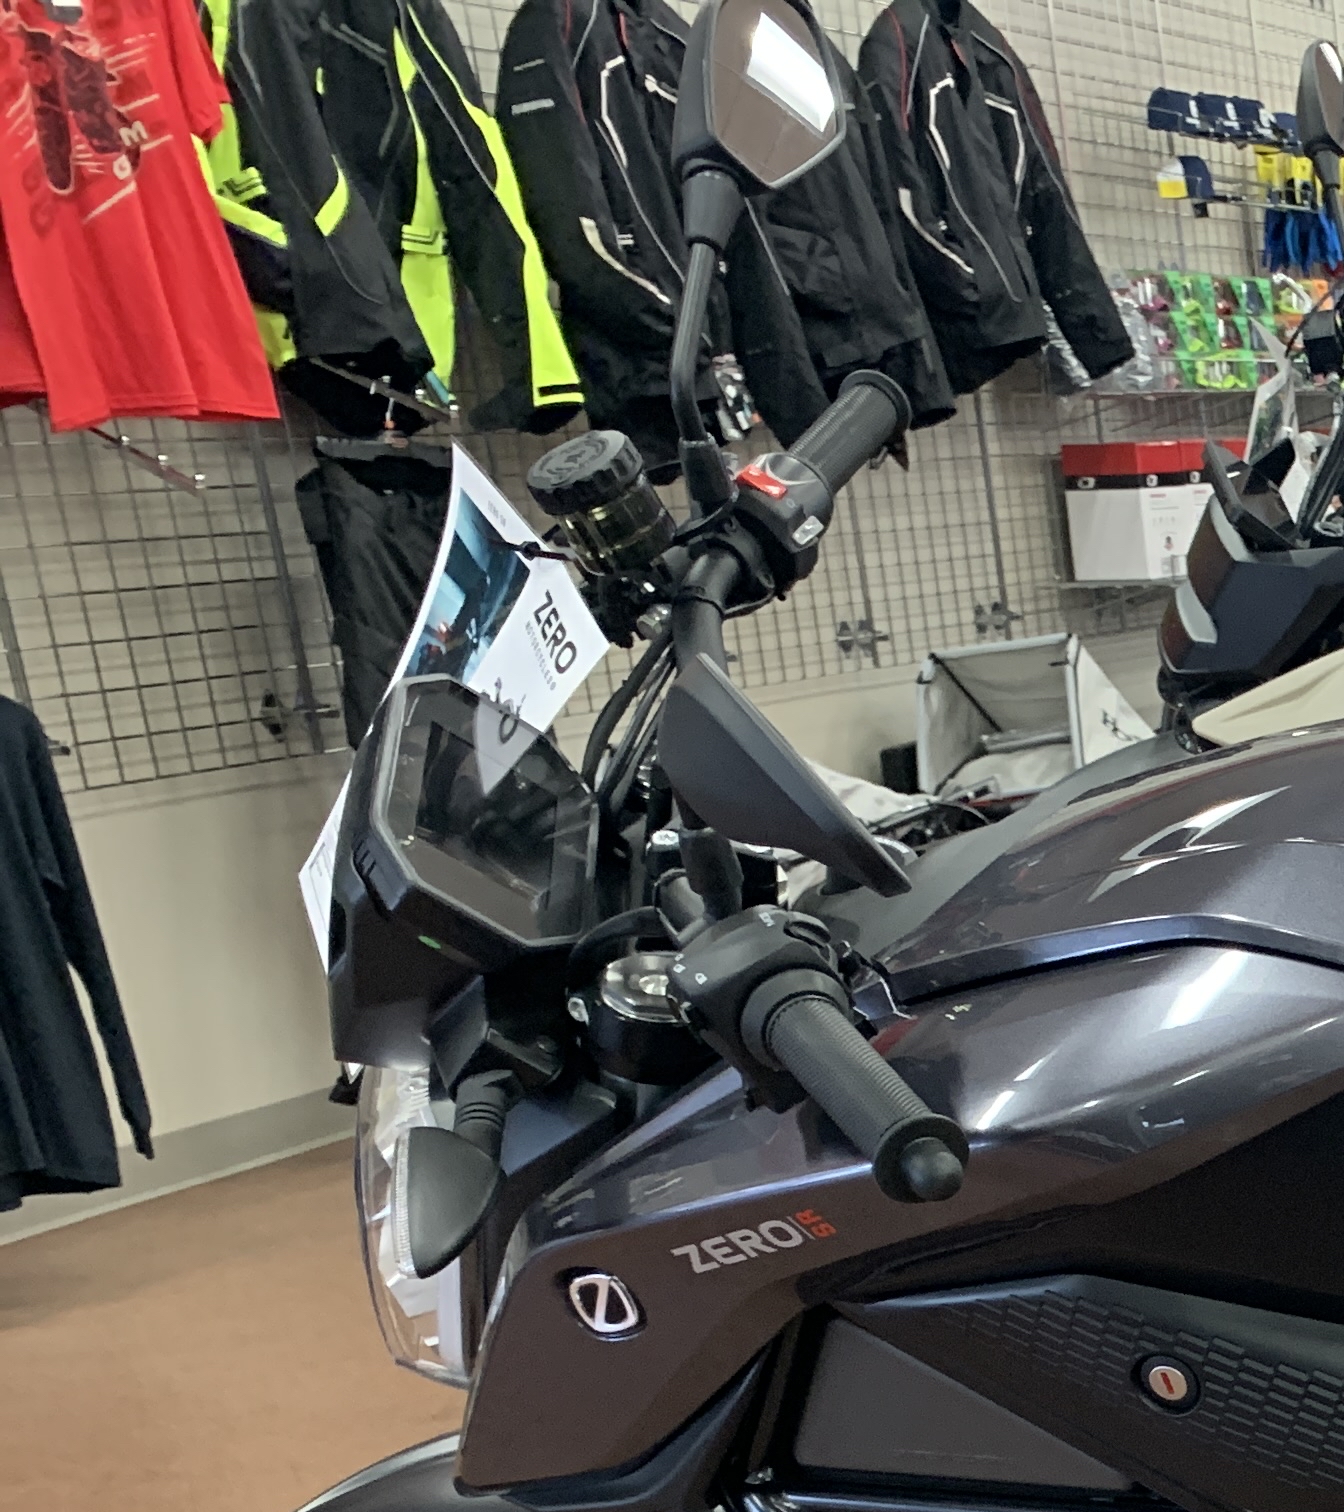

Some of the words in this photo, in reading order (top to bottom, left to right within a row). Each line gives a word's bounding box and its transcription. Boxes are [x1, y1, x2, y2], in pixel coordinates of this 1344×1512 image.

[533, 589, 577, 674] ZERO
[670, 1220, 804, 1274] ZERO
[794, 1208, 837, 1238] SR
